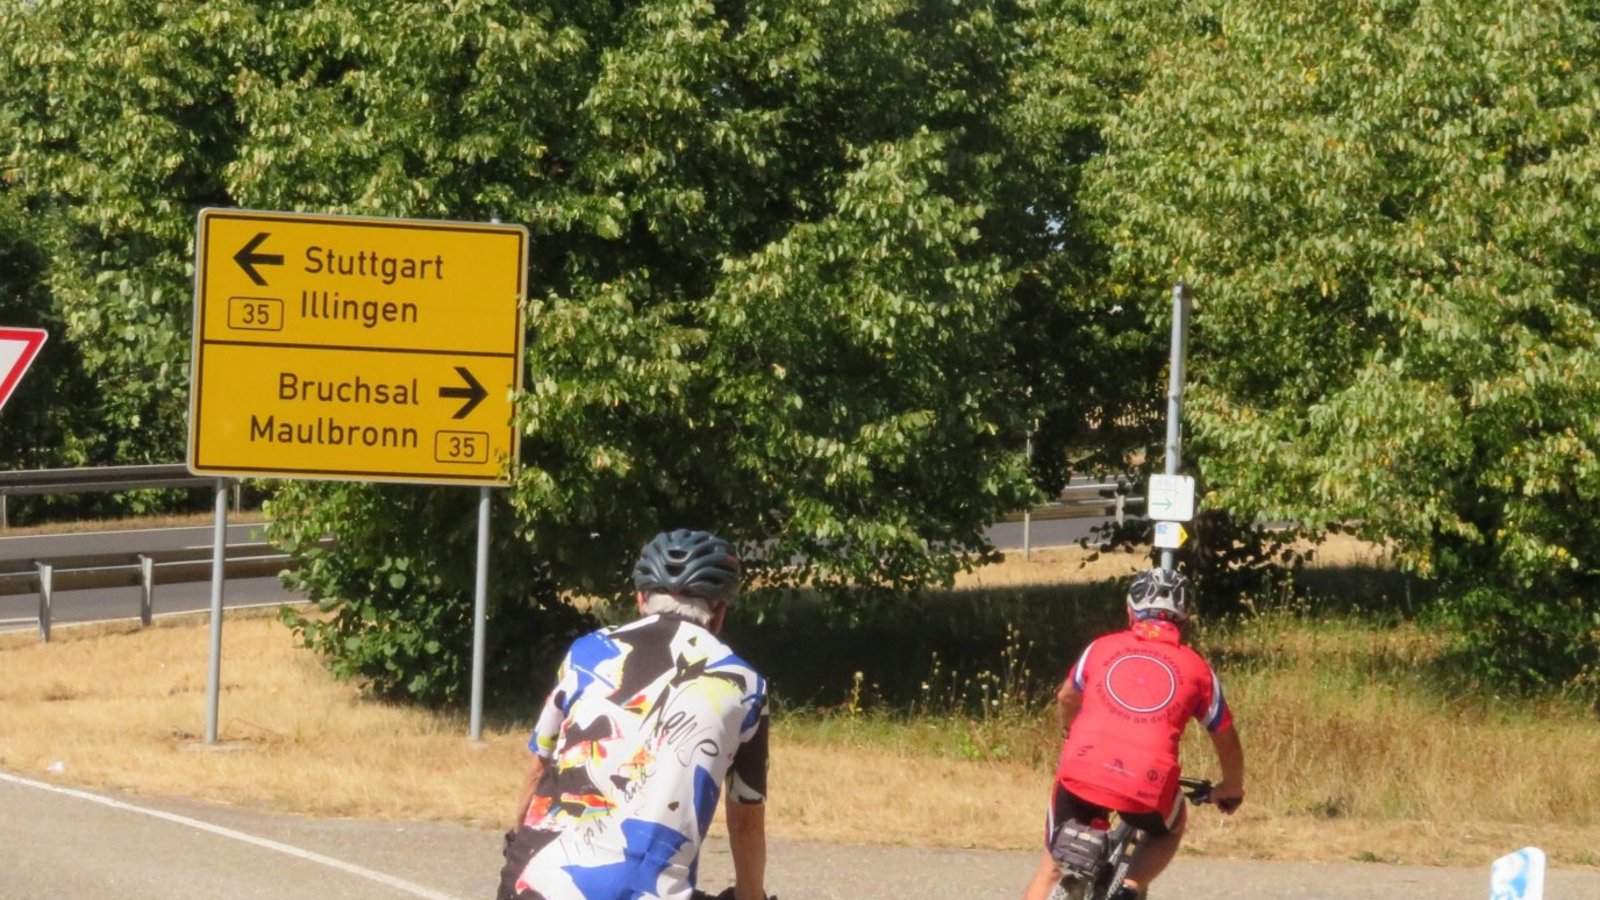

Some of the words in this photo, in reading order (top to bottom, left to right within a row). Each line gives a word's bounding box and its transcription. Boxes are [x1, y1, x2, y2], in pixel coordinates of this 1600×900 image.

[304, 245, 444, 285] Stuttgart
[242, 303, 270, 325] 35
[300, 290, 418, 328] Illingen
[278, 372, 419, 406] Bruchsal
[249, 415, 418, 448] Maulbronn
[448, 437, 475, 458] 35
